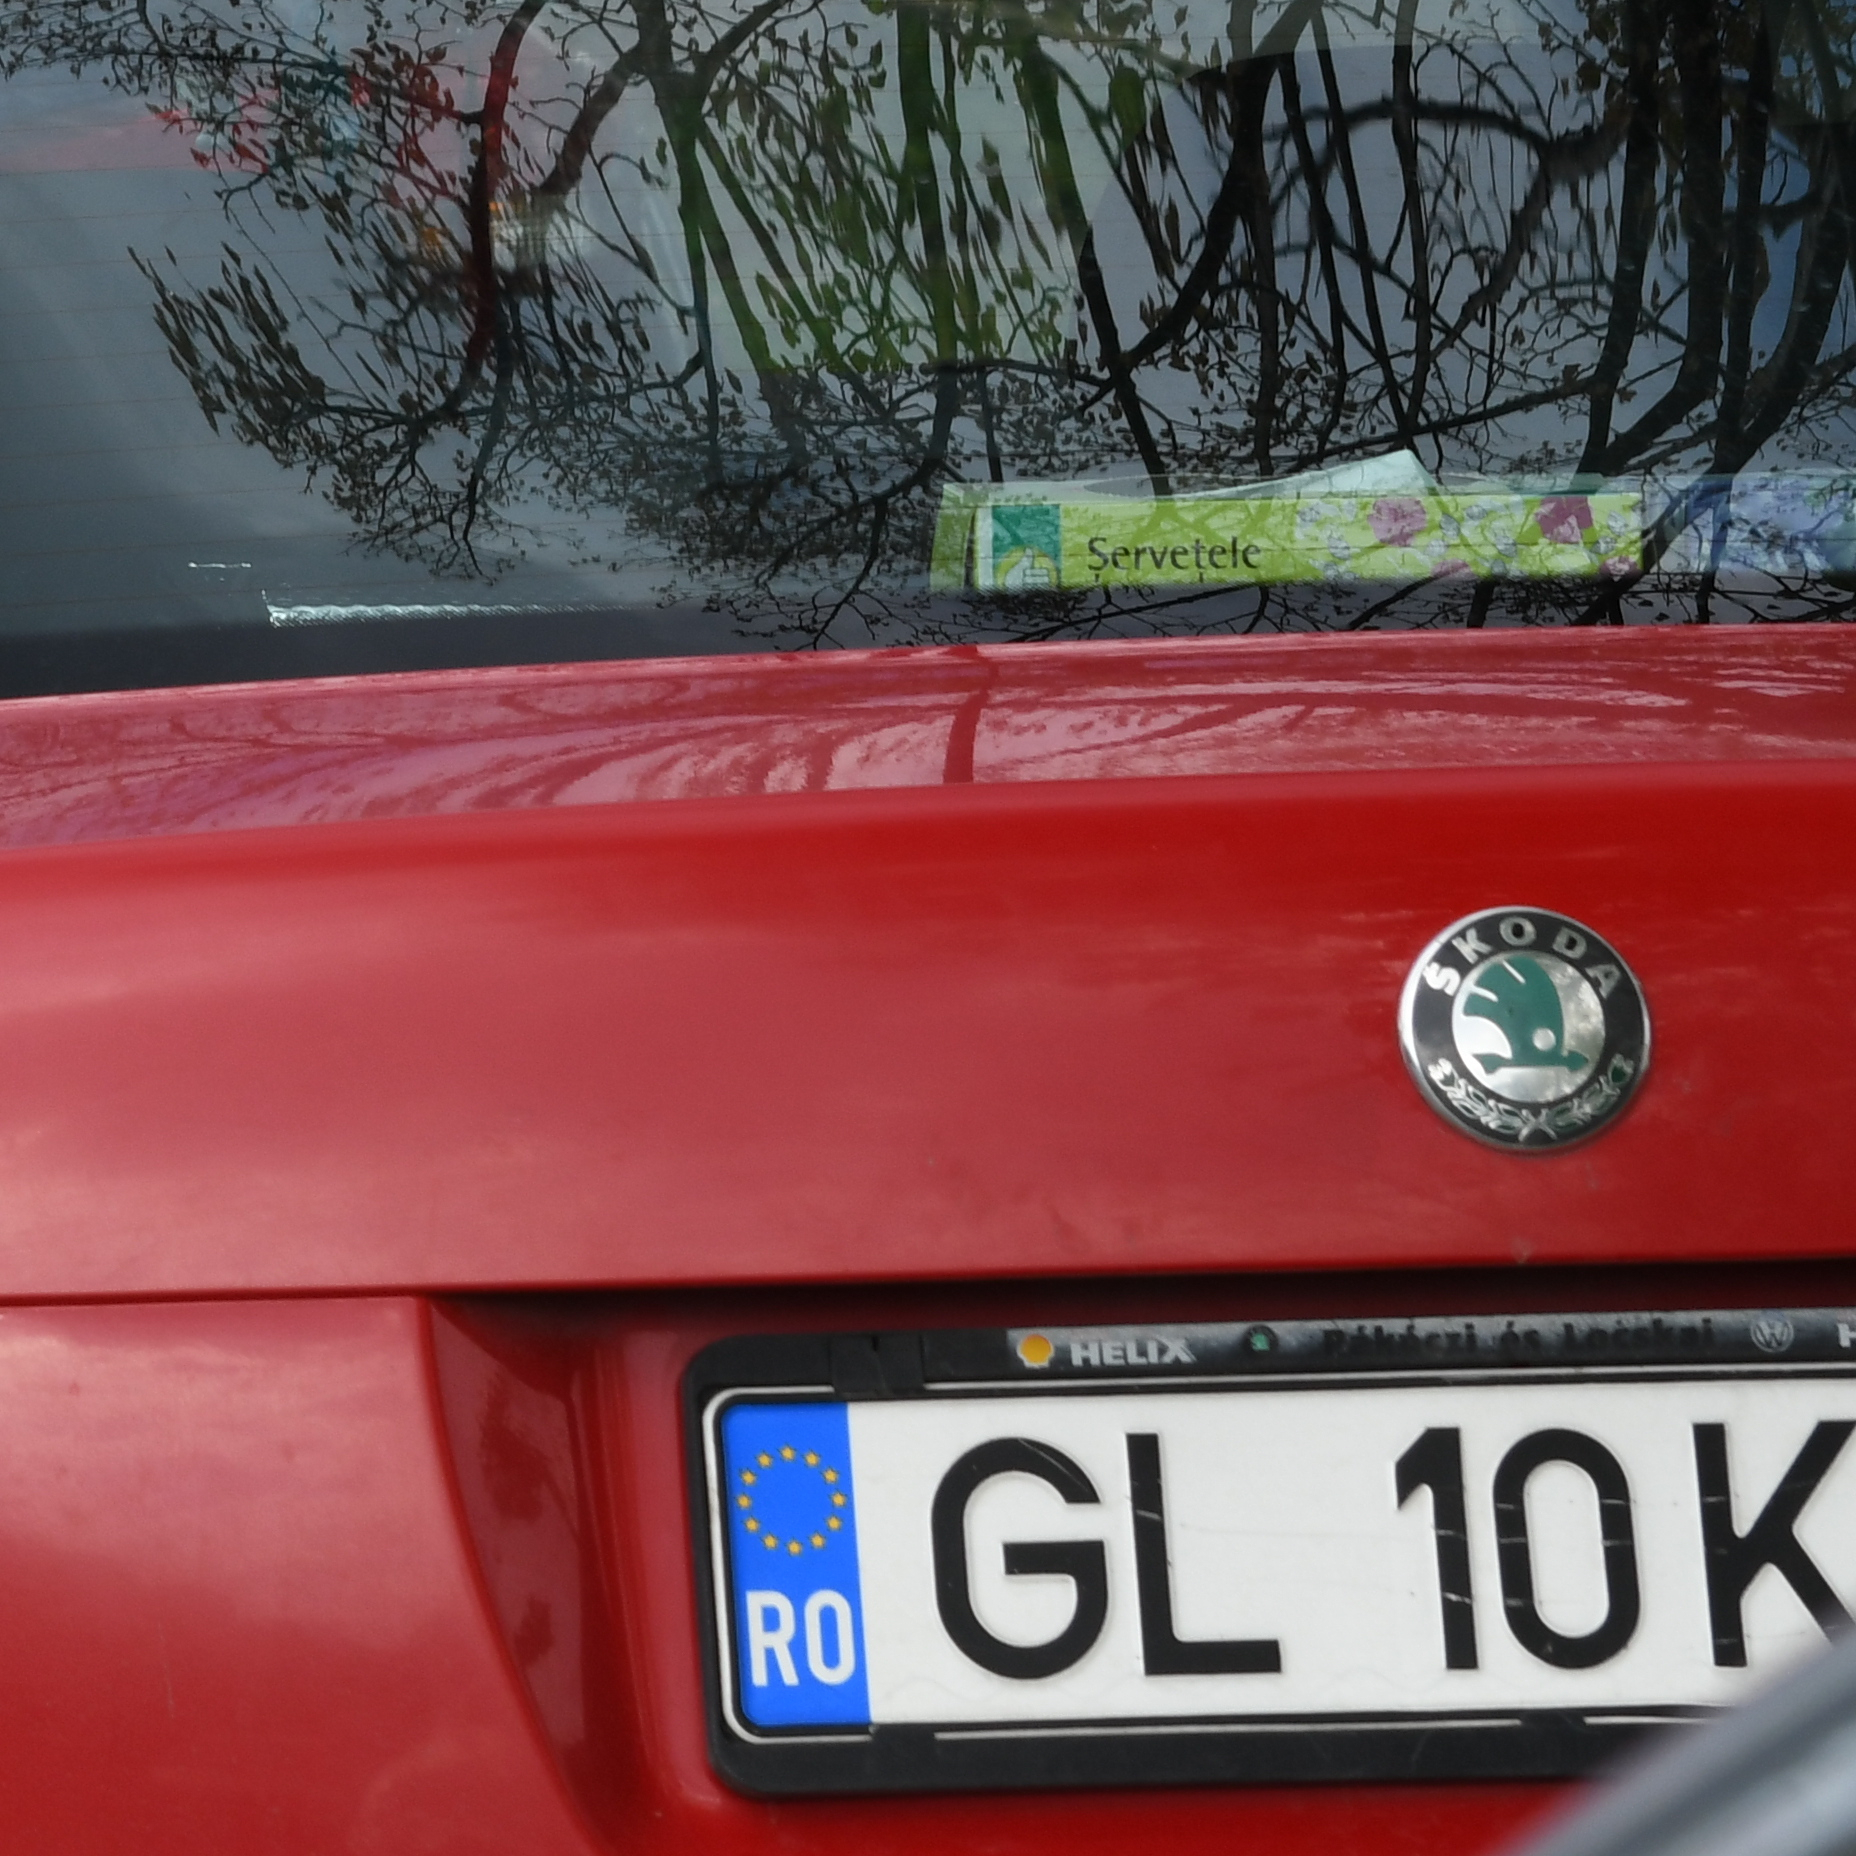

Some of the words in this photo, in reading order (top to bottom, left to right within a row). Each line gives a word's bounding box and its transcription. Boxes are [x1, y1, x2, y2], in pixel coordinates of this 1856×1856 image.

[1070, 1336, 1197, 1368] HELIX
[930, 1430, 1282, 1681] GL
[1393, 1426, 1643, 1671] 10
[745, 1588, 857, 1689] RO
